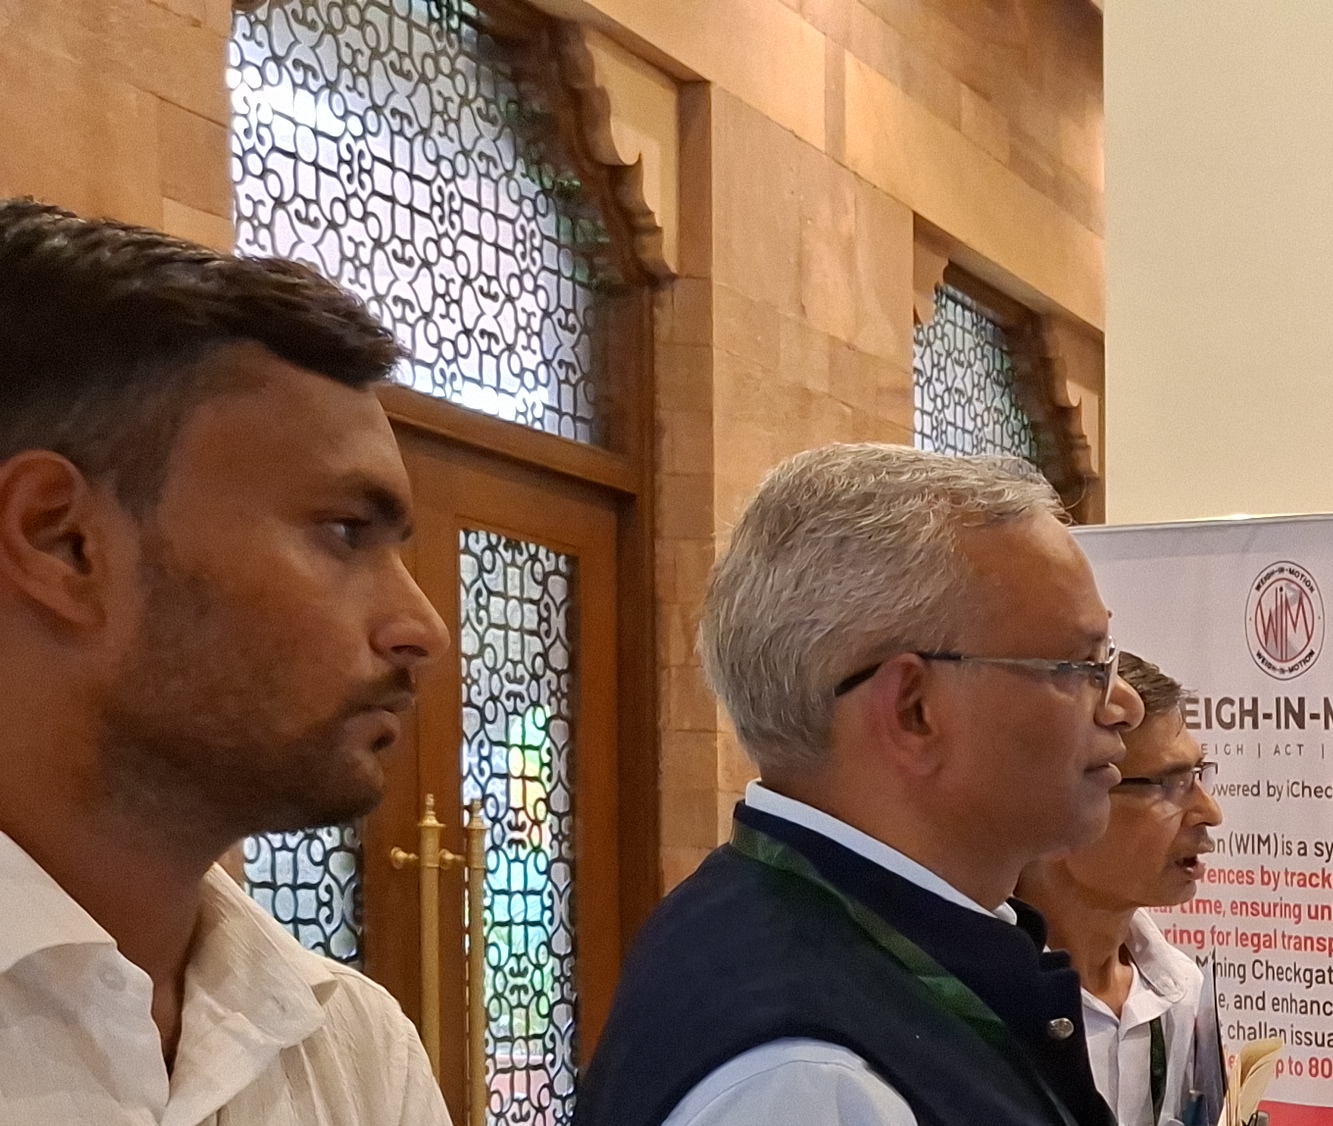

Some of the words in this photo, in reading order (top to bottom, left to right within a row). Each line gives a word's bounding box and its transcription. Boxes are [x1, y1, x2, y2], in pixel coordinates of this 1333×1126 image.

[1201, 743, 1244, 756] EIGH
[1273, 744, 1305, 757] ACT
[1266, 780, 1284, 802] by
[1229, 831, 1278, 858] (WIM)
[1281, 834, 1293, 856] is
[1297, 840, 1308, 857] a
[1260, 864, 1280, 891] by
[1230, 896, 1301, 924] ensuring
[1210, 925, 1231, 946] for
[1235, 927, 1277, 953] legal
[1234, 991, 1265, 1011] and
[1288, 1056, 1303, 1076] to
[1308, 1056, 1333, 1078] 80
